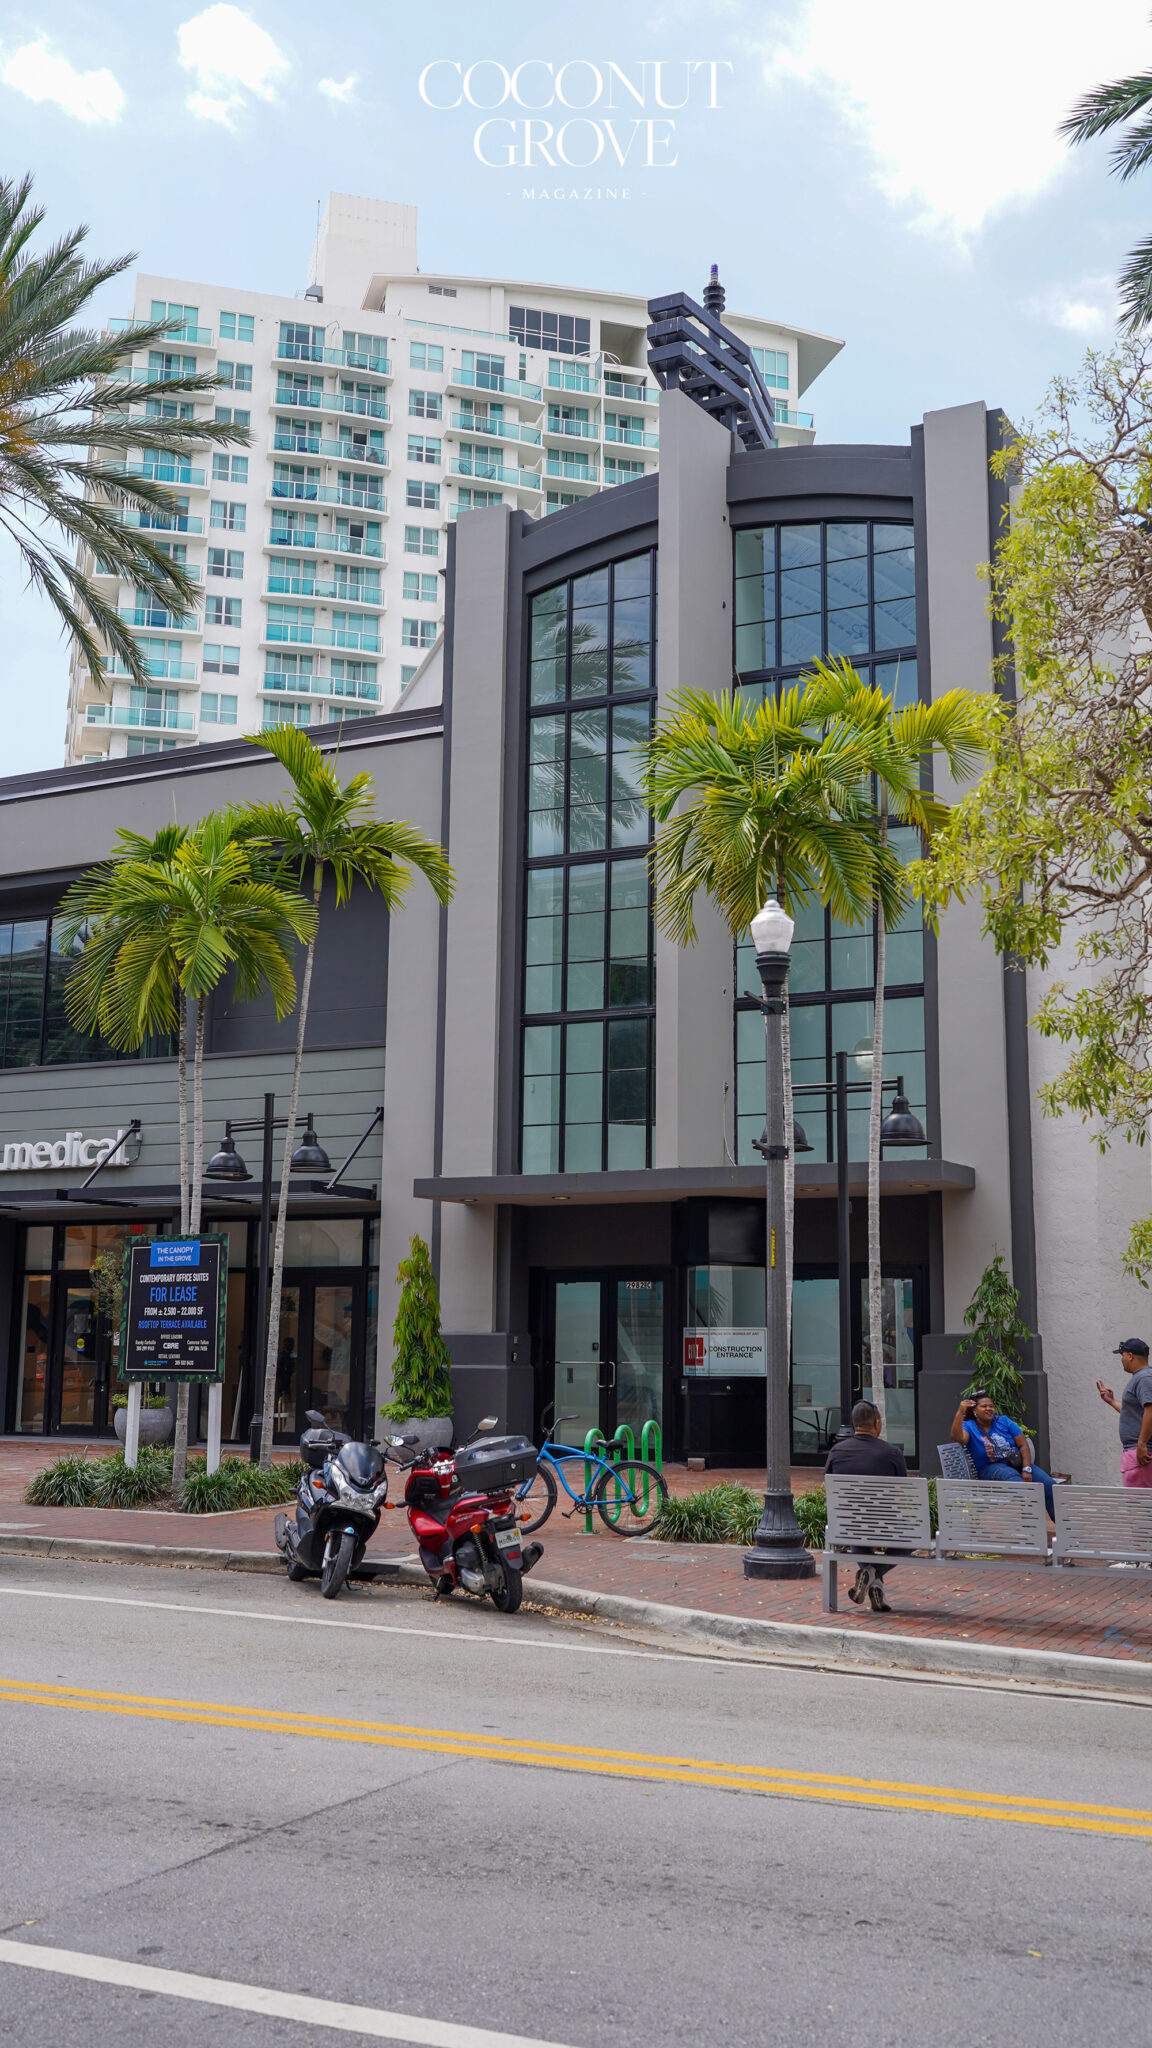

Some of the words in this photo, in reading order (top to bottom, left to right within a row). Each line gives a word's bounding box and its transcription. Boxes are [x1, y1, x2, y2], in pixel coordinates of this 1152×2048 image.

[169, 1246, 194, 1254] CANOPY
[140, 1273, 175, 1283] CONTEMPORARY
[176, 1273, 192, 1282] OFFICE
[192, 1272, 209, 1281] SUITES
[149, 1286, 167, 1302] FOR
[169, 1286, 197, 1302] LEASE
[144, 1307, 158, 1316] FROM
[197, 1306, 204, 1315] SF
[138, 1320, 159, 1329] ROOFTOP
[160, 1320, 180, 1329] TERRACE
[181, 1319, 207, 1328] AVAILABLE
[162, 1342, 179, 1350] CBRE
